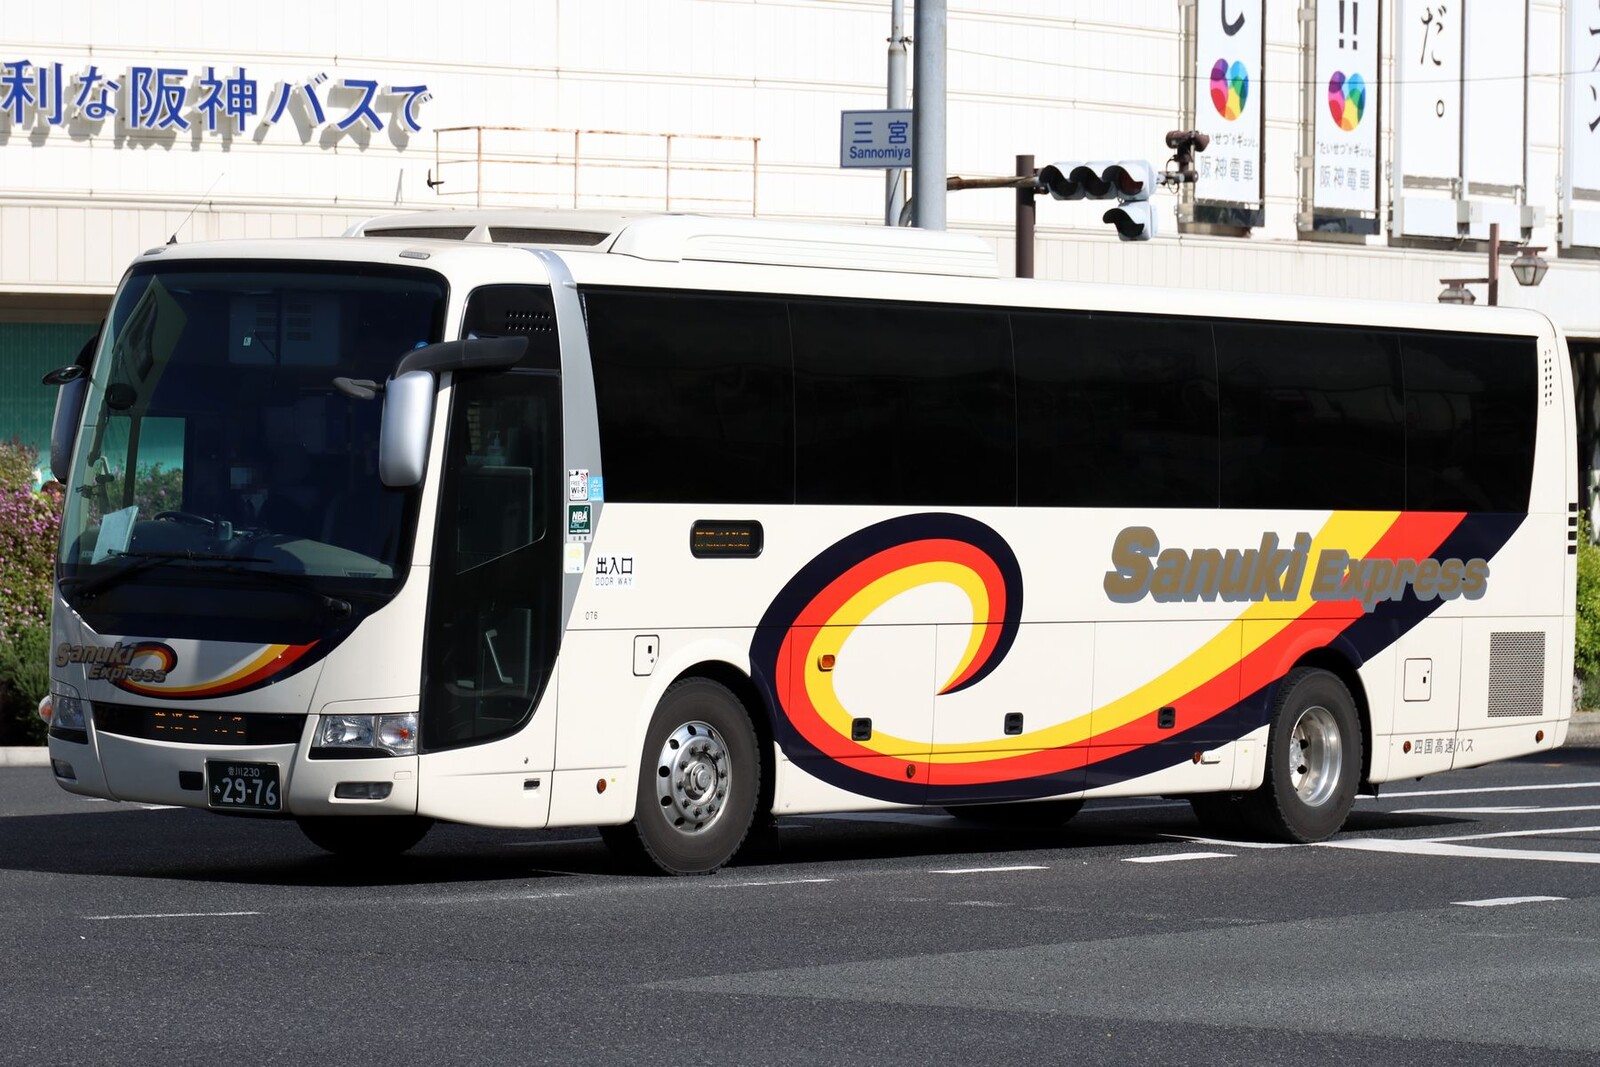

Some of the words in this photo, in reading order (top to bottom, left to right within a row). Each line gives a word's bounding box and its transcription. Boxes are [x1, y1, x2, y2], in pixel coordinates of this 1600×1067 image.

[1, 59, 433, 132] 利な阪神バスで
[853, 120, 909, 144] 三宮
[849, 145, 911, 160] Sannomiya
[570, 486, 587, 494] Wi-Fi
[572, 511, 588, 523] NBA
[595, 556, 633, 575] 出入口
[1103, 526, 1312, 603] Sanuki
[1310, 549, 1490, 613] Express
[595, 576, 614, 586] DOOR
[617, 577, 633, 586] WAY
[585, 611, 598, 620] 076
[56, 641, 137, 668] Sanuki
[88, 663, 167, 683] Express
[1414, 738, 1474, 754] 四国高速バス
[222, 777, 277, 806] 29-76
